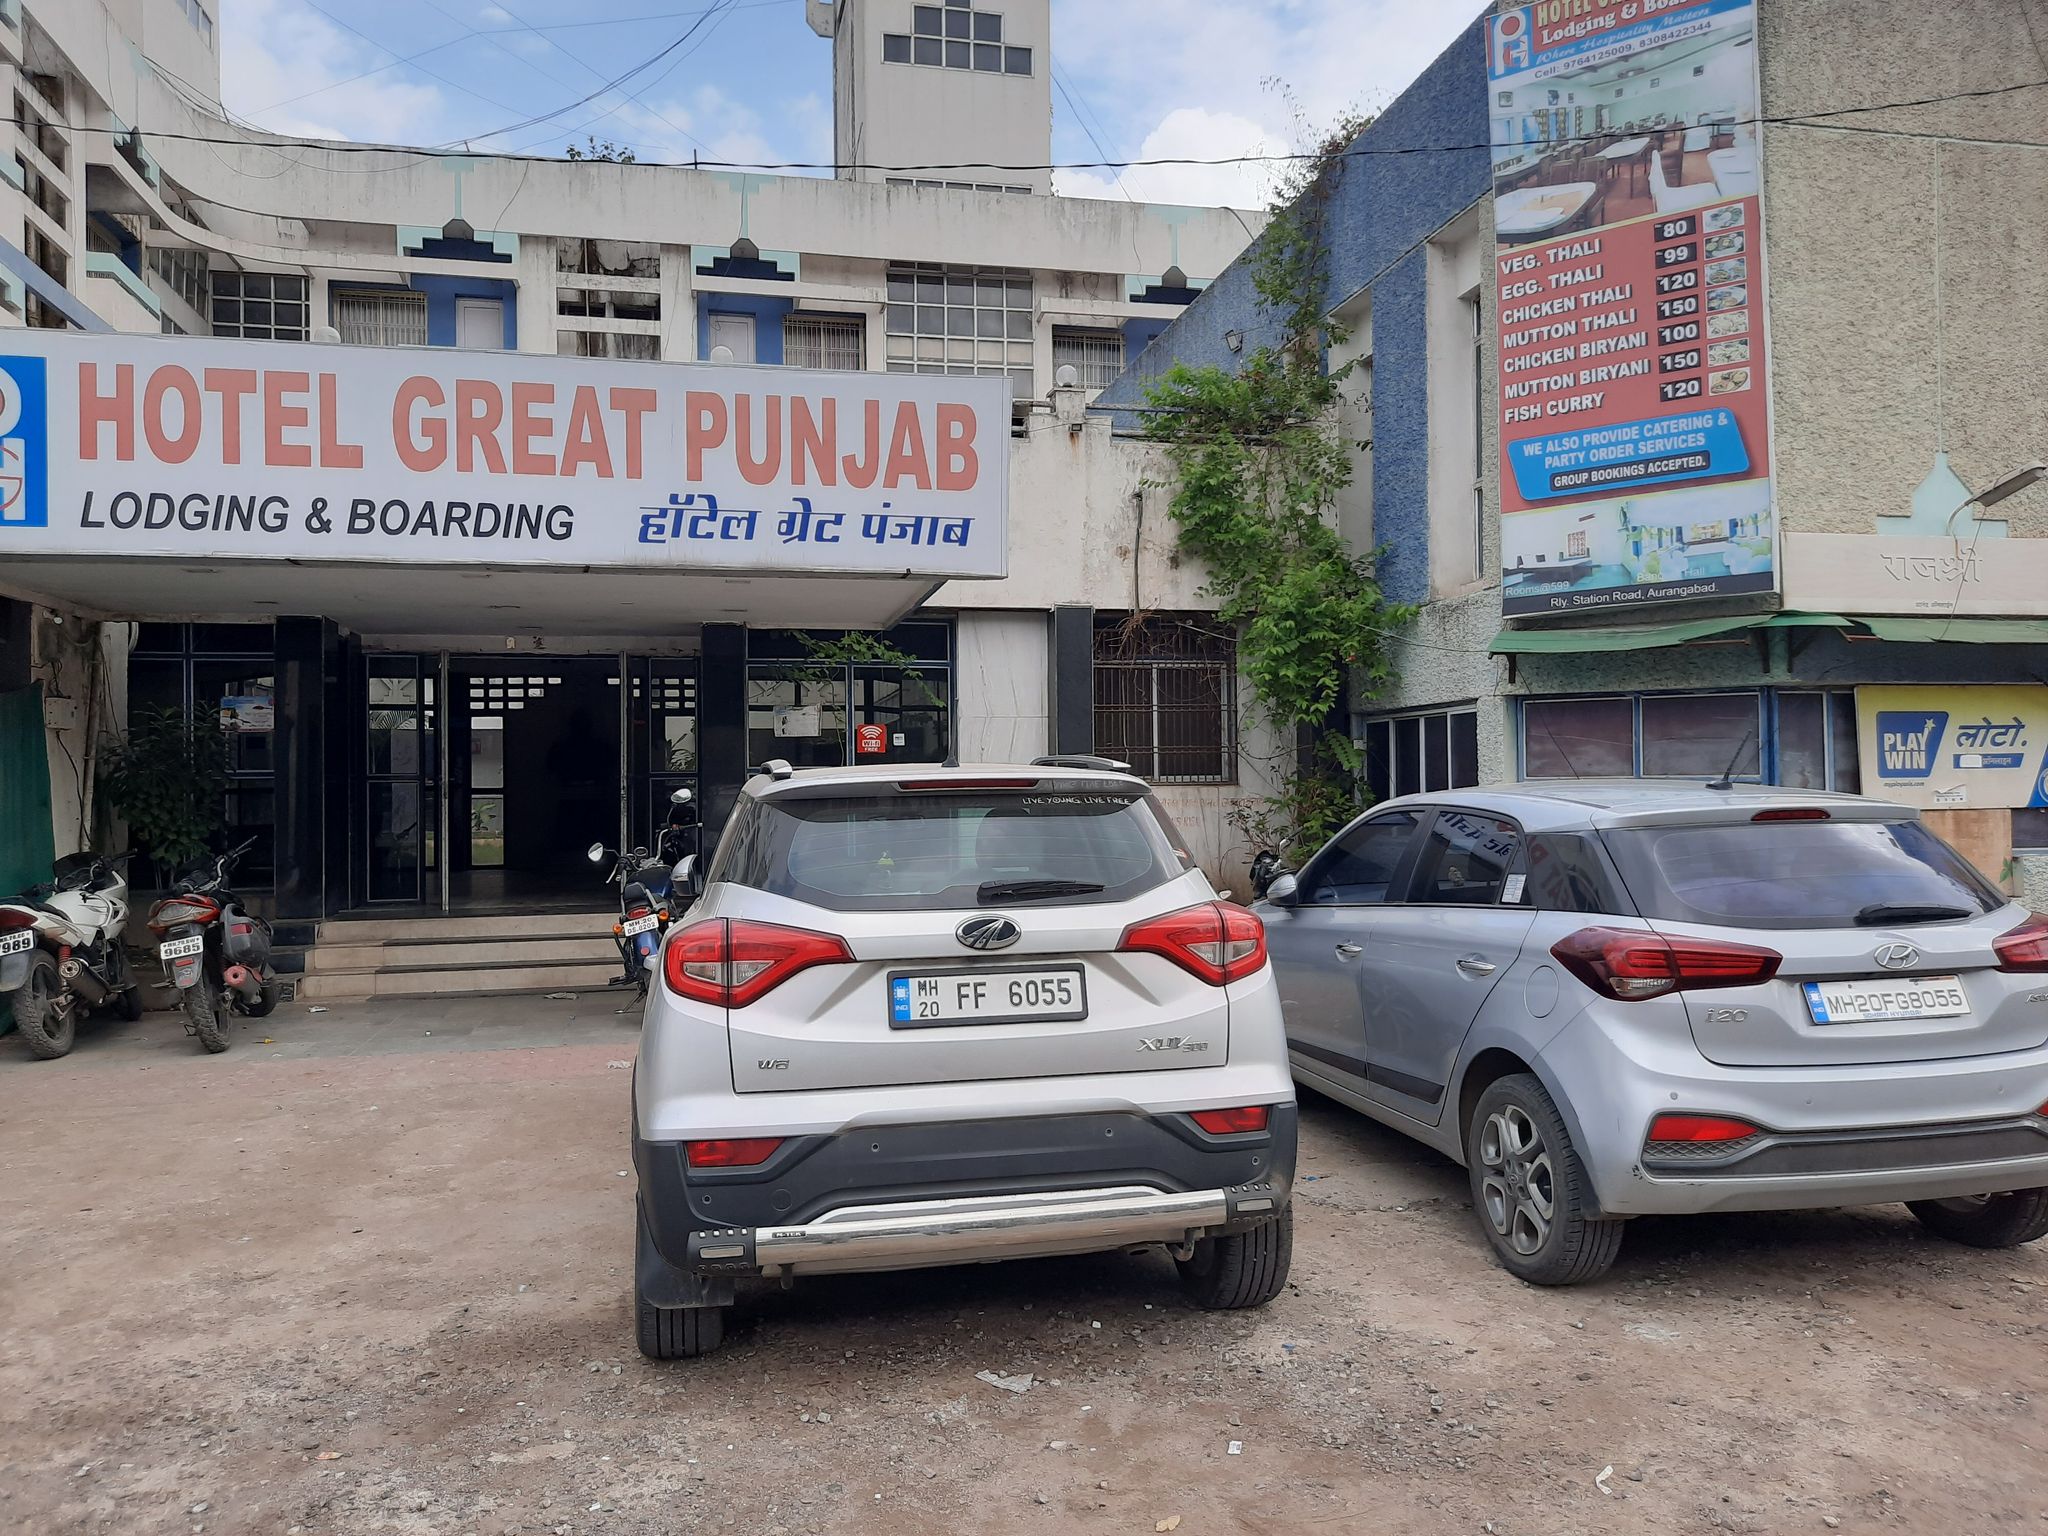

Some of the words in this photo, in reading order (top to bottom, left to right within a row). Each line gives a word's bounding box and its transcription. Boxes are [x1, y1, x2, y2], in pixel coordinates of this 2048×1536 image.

[1537, 0, 1592, 27] HOTEL
[1541, 12, 1616, 45] Lodging
[1621, 3, 1638, 19] &
[1534, 66, 1559, 79] Cell:
[1639, 21, 1712, 47] 8308422344
[1536, 48, 1576, 65] Where
[1579, 23, 1653, 52] Hospitality
[1655, 8, 1709, 32] Matters
[1500, 254, 1541, 275] VEG.
[1546, 239, 1601, 264] THALI
[1663, 220, 1688, 237] 80
[1501, 280, 1543, 300] EGG.
[1548, 264, 1603, 289] THALI
[1664, 246, 1688, 264] 99
[1502, 297, 1576, 325] CHICKEN
[1580, 284, 1632, 308] THALI
[1659, 272, 1695, 292] 120
[1503, 321, 1577, 349] MUTTON
[1581, 308, 1636, 332] THALI
[1660, 298, 1697, 317] 150
[1503, 346, 1575, 374] CHICKEN
[1581, 332, 1648, 358] BIRYANI
[1661, 324, 1697, 342] 100
[1504, 373, 1574, 400] MUTTON
[1580, 359, 1651, 385] BIRYANI
[1662, 351, 1699, 370] 150
[1504, 403, 1542, 423] FISH
[1546, 392, 1605, 414] CURRY
[1663, 380, 1699, 399] 120
[78, 362, 364, 470] HOTEL
[392, 375, 657, 480] GREAT
[685, 391, 979, 491] PUNJAB
[1523, 444, 1543, 457] WE
[1547, 437, 1579, 454] ALSO
[1583, 426, 1640, 448] PROVIDE
[1643, 414, 1713, 438] CATERING
[1717, 412, 1728, 426] &
[1544, 451, 1585, 469] PARTY
[1589, 444, 1634, 463] ORDER
[1638, 433, 1705, 455] SERVICES
[1554, 471, 1589, 487] GROUP
[1591, 463, 1644, 483] BOOKINGS
[1647, 456, 1707, 476] ACCEPTED.
[80, 491, 289, 533] LODGING
[305, 497, 333, 534] &
[347, 498, 575, 541] BOARDING
[638, 493, 762, 544] हॉटेल
[777, 497, 846, 545] ग्रेट
[862, 502, 976, 547] पंजाब
[1550, 596, 1569, 609] Rly.
[1572, 591, 1609, 606] Station
[1612, 588, 1644, 602] Road,
[1647, 582, 1718, 600] Aurangabad.
[1883, 728, 1929, 751] PLAY
[1884, 751, 1926, 769] WIN
[0, 938, 31, 953] 989
[164, 943, 201, 957] 9685
[918, 980, 939, 997] MH
[957, 982, 987, 1010] FF
[1008, 978, 1072, 1007] 6055
[919, 1001, 939, 1018] 20
[1826, 989, 1963, 1015] MH20FG8055
[1705, 1008, 1748, 1023] i20
